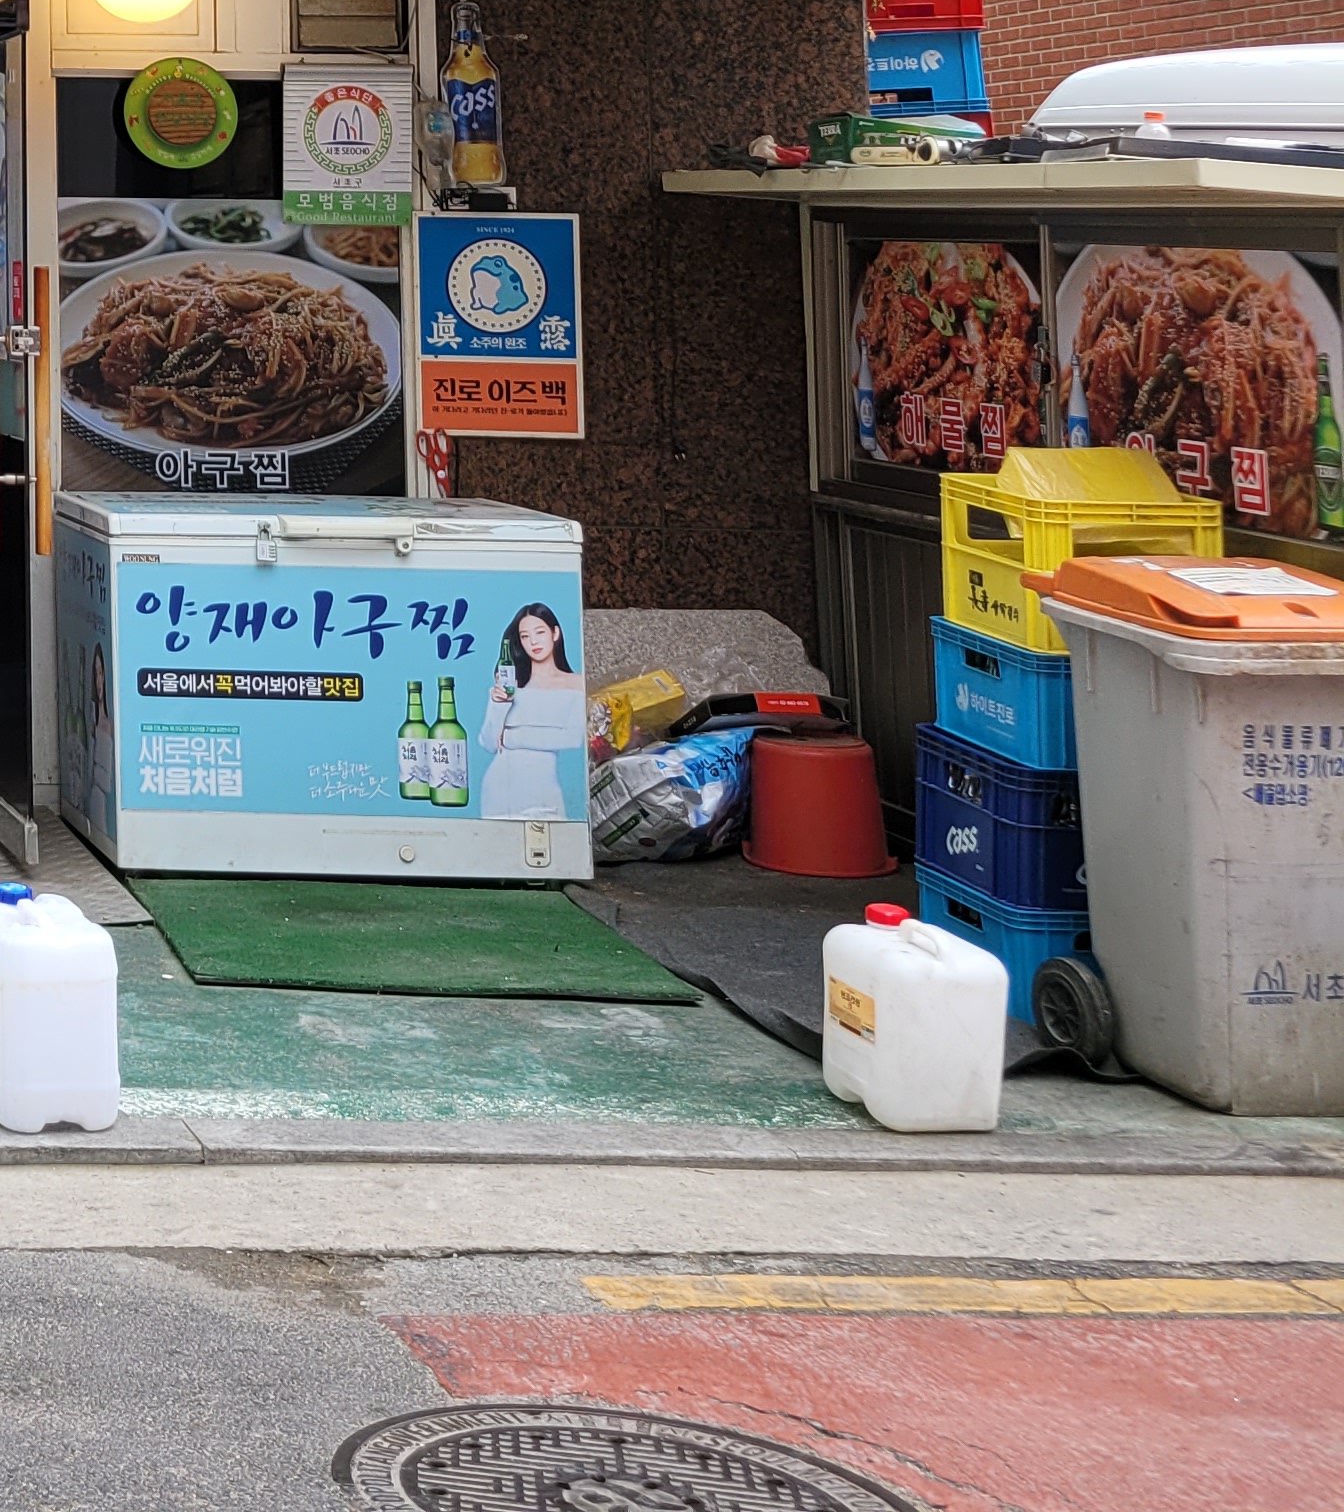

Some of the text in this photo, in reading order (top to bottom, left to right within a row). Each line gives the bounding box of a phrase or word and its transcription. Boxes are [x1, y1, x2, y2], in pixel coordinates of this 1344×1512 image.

[323, 88, 373, 104] 좋은식단
[325, 147, 370, 155] 서초 SEOCHO
[333, 177, 362, 187] 서초구
[296, 193, 397, 211] 모범음식점
[297, 211, 397, 223] Good Restaurant
[469, 336, 527, 350] 소주의 원조
[900, 391, 1007, 459] 해물찜
[155, 449, 290, 489] 아구찜
[136, 586, 476, 661] 양재아구찜
[970, 692, 1015, 725] 하이트진로
[138, 735, 242, 766] 새로워진
[308, 760, 372, 779] 더 부드럽지만
[139, 765, 243, 797] 처음처럼
